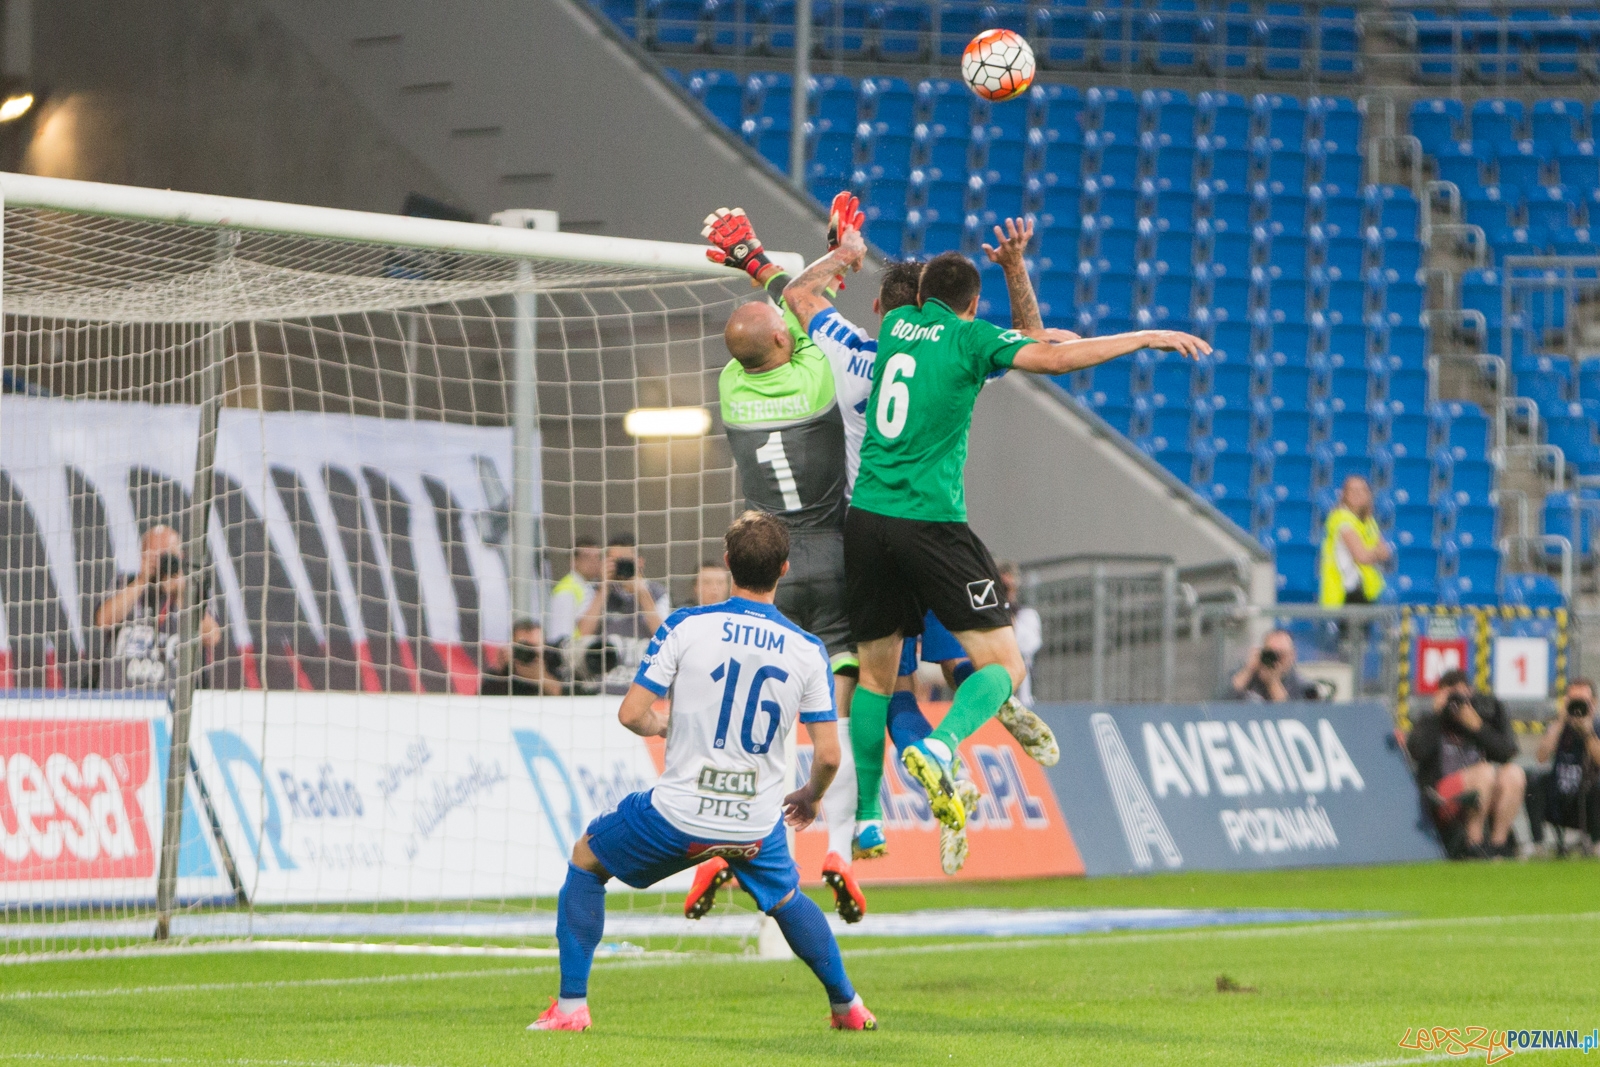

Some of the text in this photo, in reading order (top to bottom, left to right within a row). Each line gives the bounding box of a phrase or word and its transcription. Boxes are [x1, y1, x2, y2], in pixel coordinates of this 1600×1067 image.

[729, 394, 811, 421] PETROVSKI
[876, 353, 917, 439] 6
[755, 430, 803, 512] 1
[721, 616, 786, 654] ŠITUM
[1513, 655, 1528, 685] 1
[710, 657, 789, 754] 16
[702, 768, 756, 794] LECH
[1141, 718, 1366, 797] AVENIDA
[0, 751, 139, 863] esa
[278, 763, 364, 818] Radio
[697, 797, 752, 822] PILS
[1219, 793, 1340, 854] POZNAŃ
